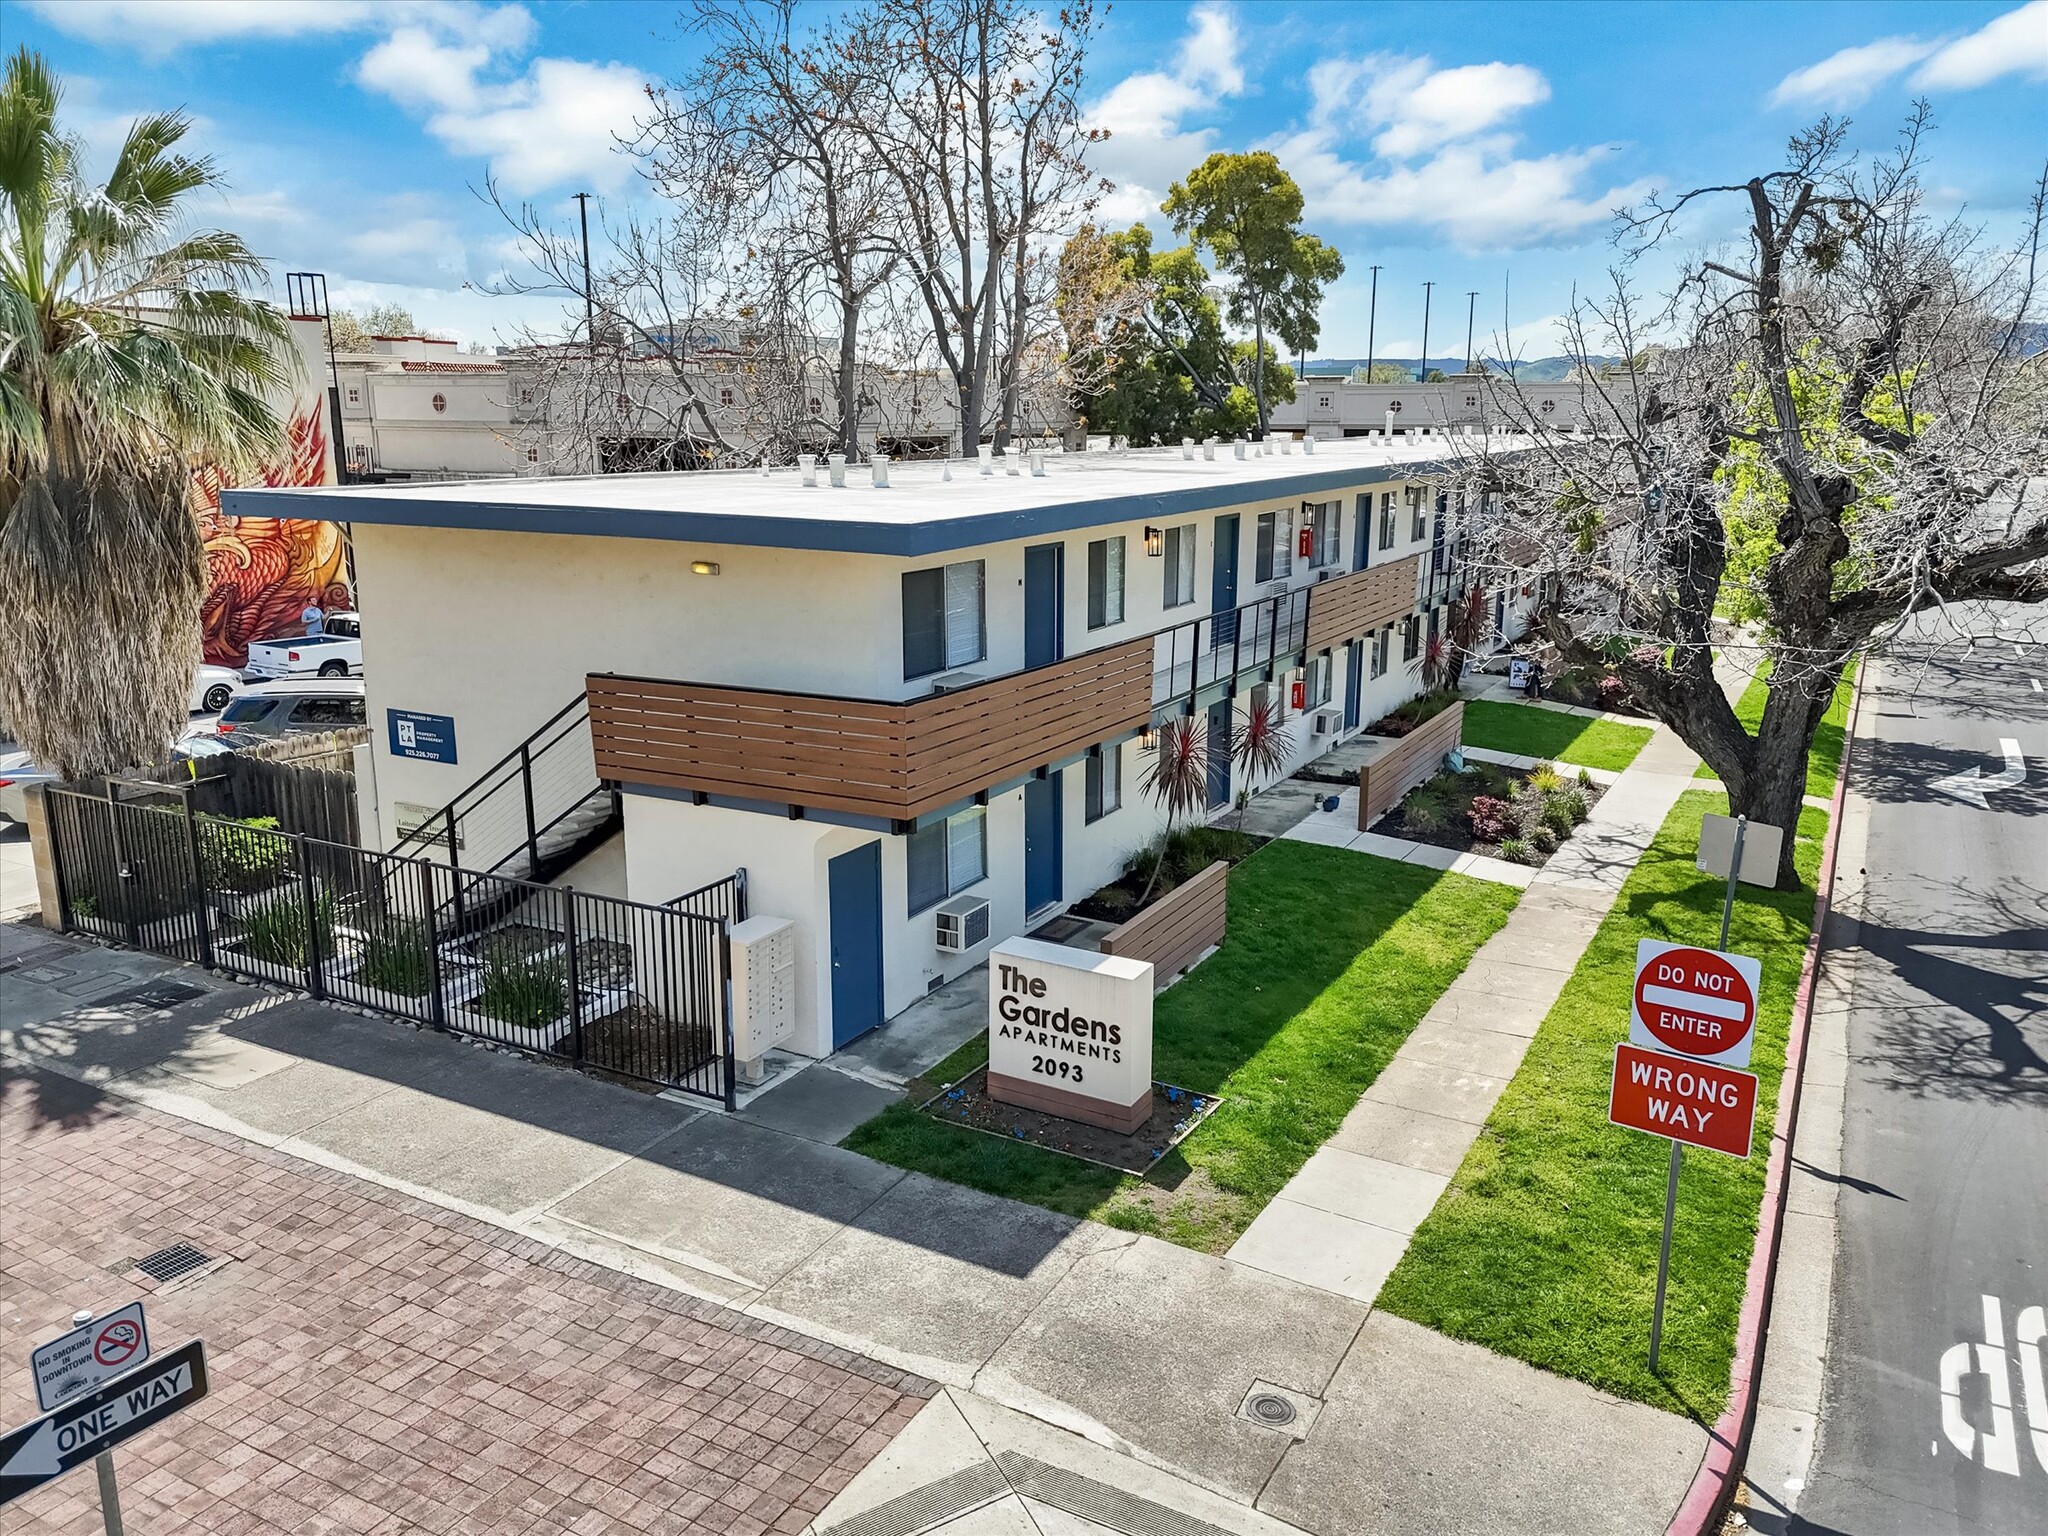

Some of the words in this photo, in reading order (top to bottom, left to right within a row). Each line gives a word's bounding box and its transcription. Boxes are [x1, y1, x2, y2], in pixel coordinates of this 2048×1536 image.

[998, 964, 1047, 998] The
[1658, 964, 1685, 984] DO
[1694, 971, 1735, 993] NOT
[998, 995, 1122, 1045] Gardens
[1659, 1011, 1722, 1040] ENTER
[999, 1024, 1121, 1064] APARTMENTS
[1031, 1055, 1084, 1083] 2093
[1630, 1060, 1739, 1109] WRONG
[1647, 1096, 1714, 1133] WAY
[38, 1355, 51, 1369] NO
[52, 1337, 91, 1362] SMOKING
[42, 1353, 93, 1384] DOWNTOWN
[61, 1356, 71, 1365] IN
[54, 1377, 88, 1400] Concord
[57, 1404, 118, 1452] ONE
[126, 1367, 183, 1417] WAY
